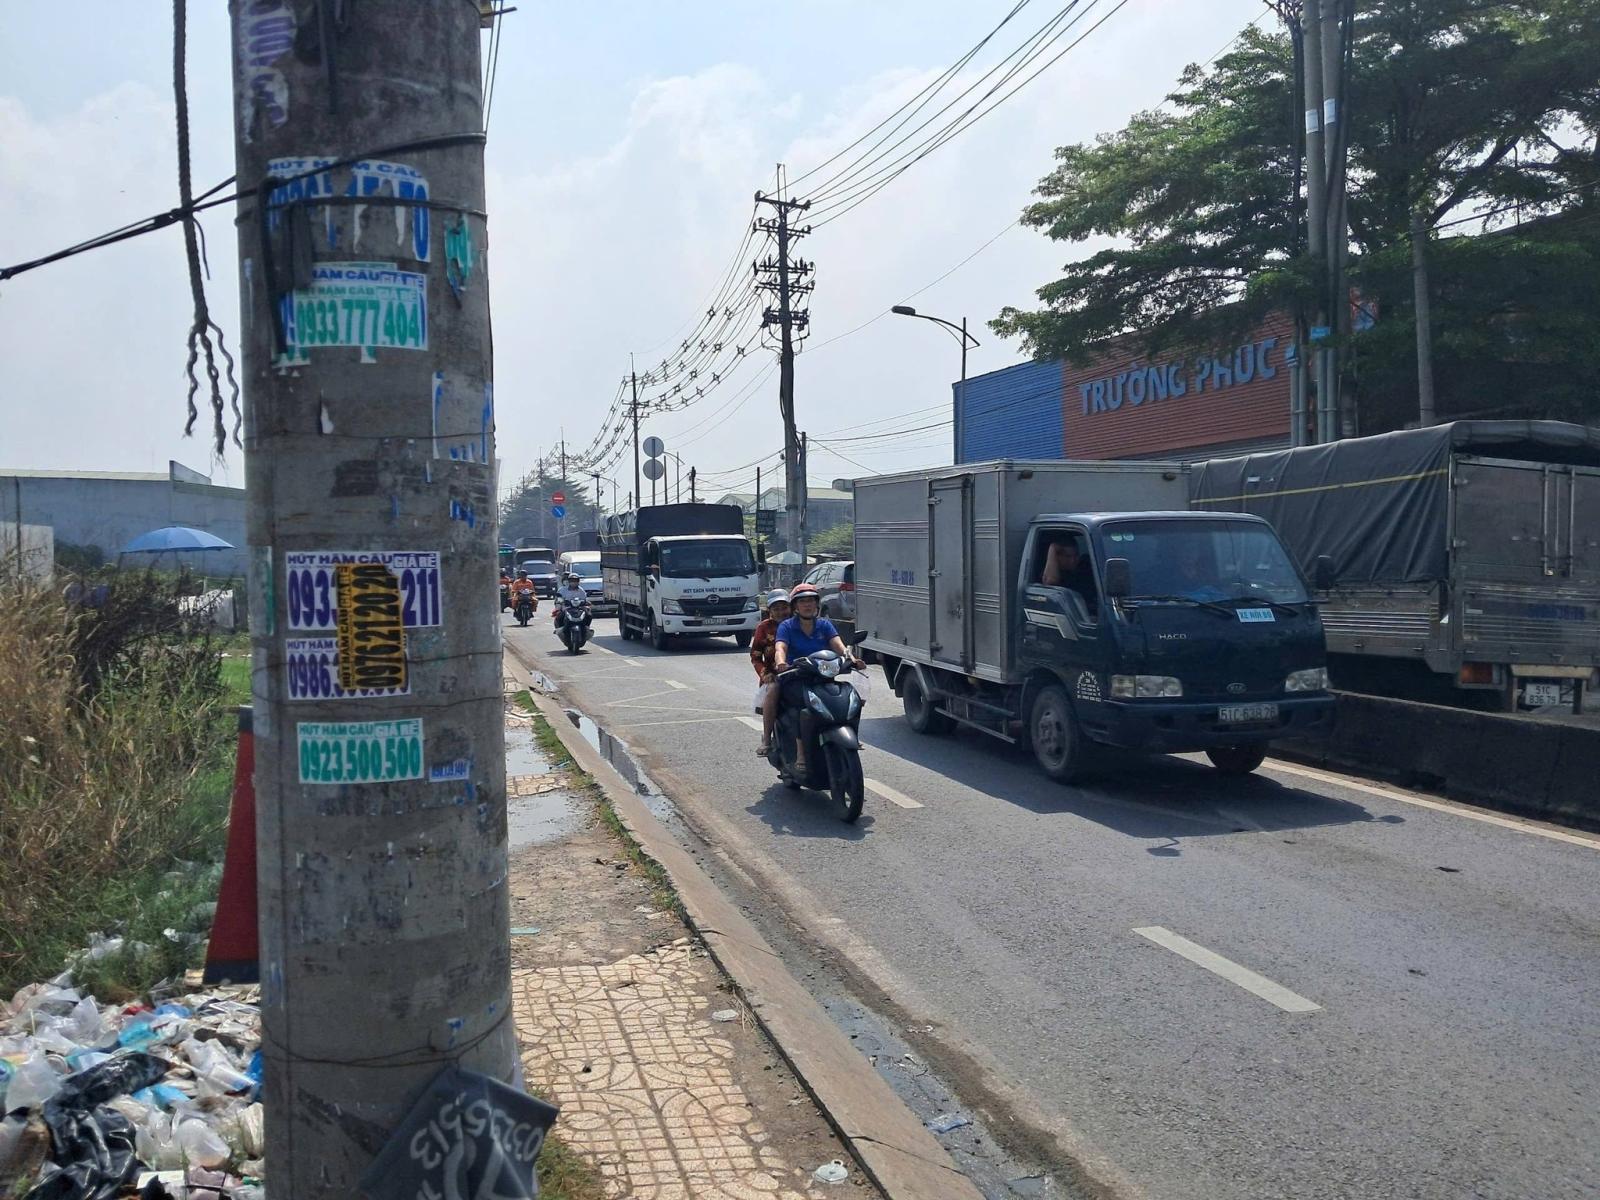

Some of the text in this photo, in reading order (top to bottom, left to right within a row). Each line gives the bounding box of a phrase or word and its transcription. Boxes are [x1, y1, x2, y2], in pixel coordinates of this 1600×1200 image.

[296, 299, 420, 347] 0933.777.404
[352, 564, 403, 687] 0976.21.20.20
[1535, 685, 1551, 695] 51C
[301, 737, 420, 781] 0923.500.500
